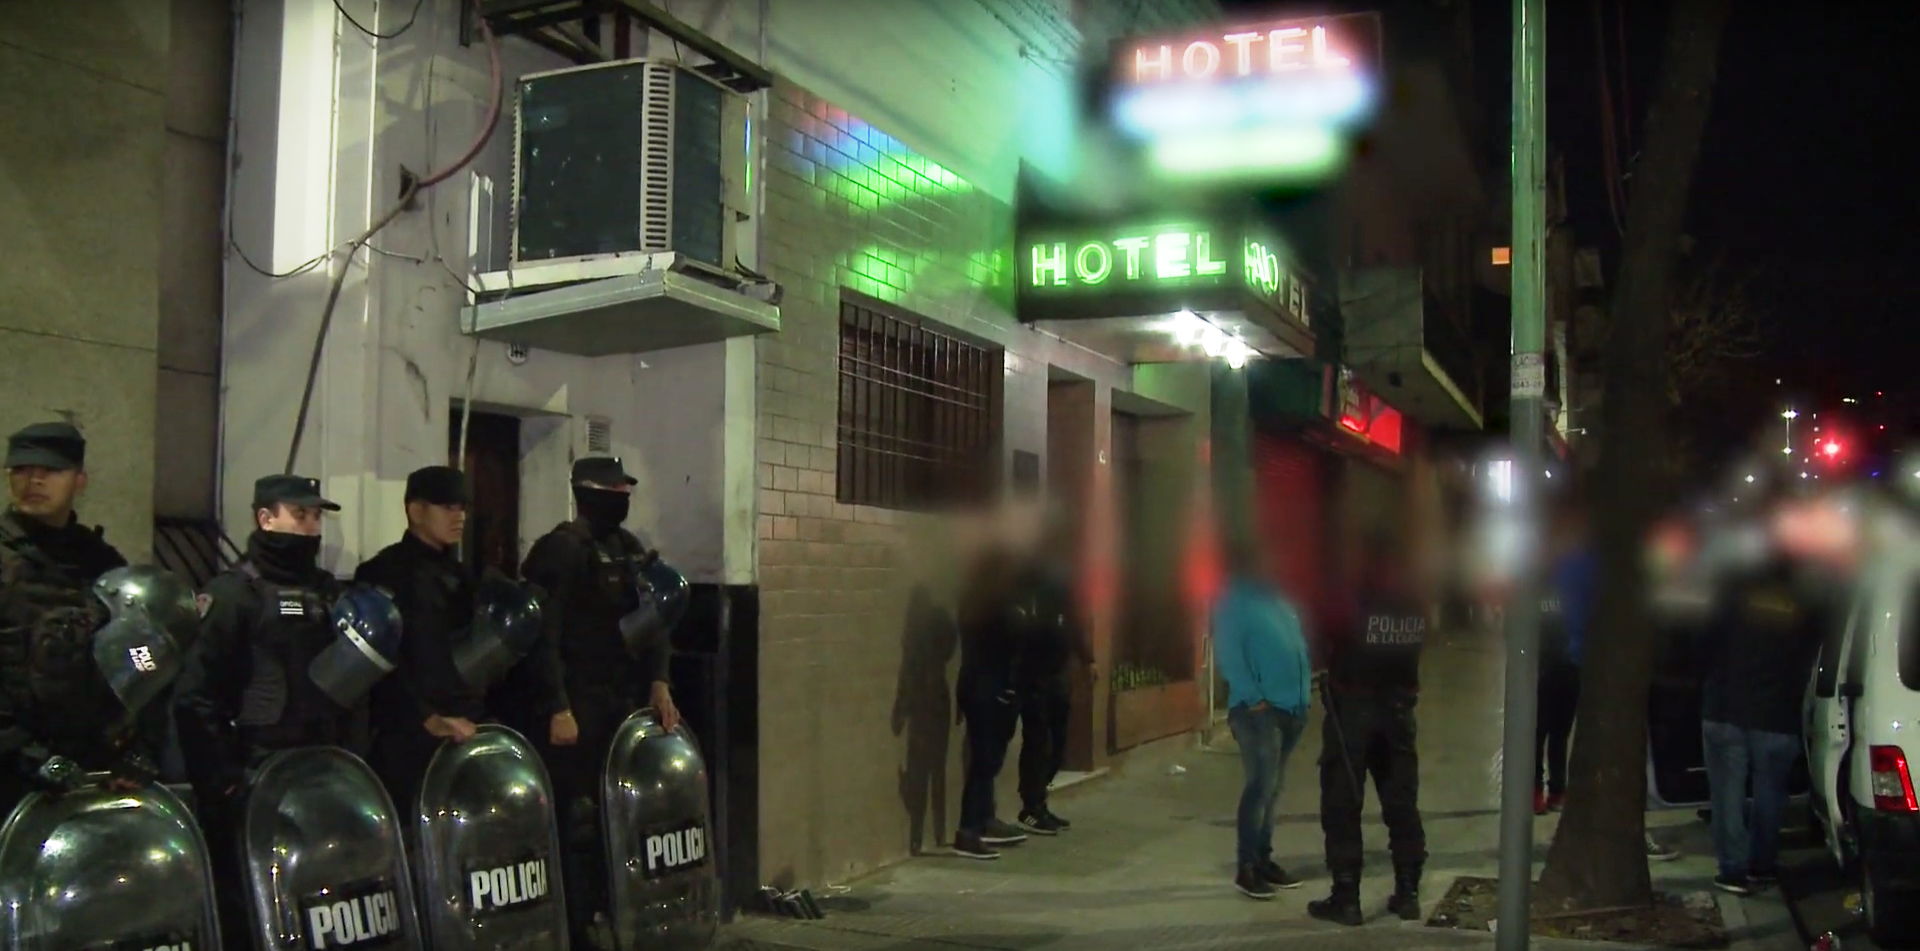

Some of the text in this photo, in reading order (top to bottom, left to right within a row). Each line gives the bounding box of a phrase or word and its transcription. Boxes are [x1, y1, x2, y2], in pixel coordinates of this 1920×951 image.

[1136, 25, 1350, 83] HOTEL
[1032, 231, 1226, 286] HOTEL
[1366, 633, 1379, 643] DE
[1381, 633, 1395, 643] LA
[1367, 615, 1425, 632] POLICIA
